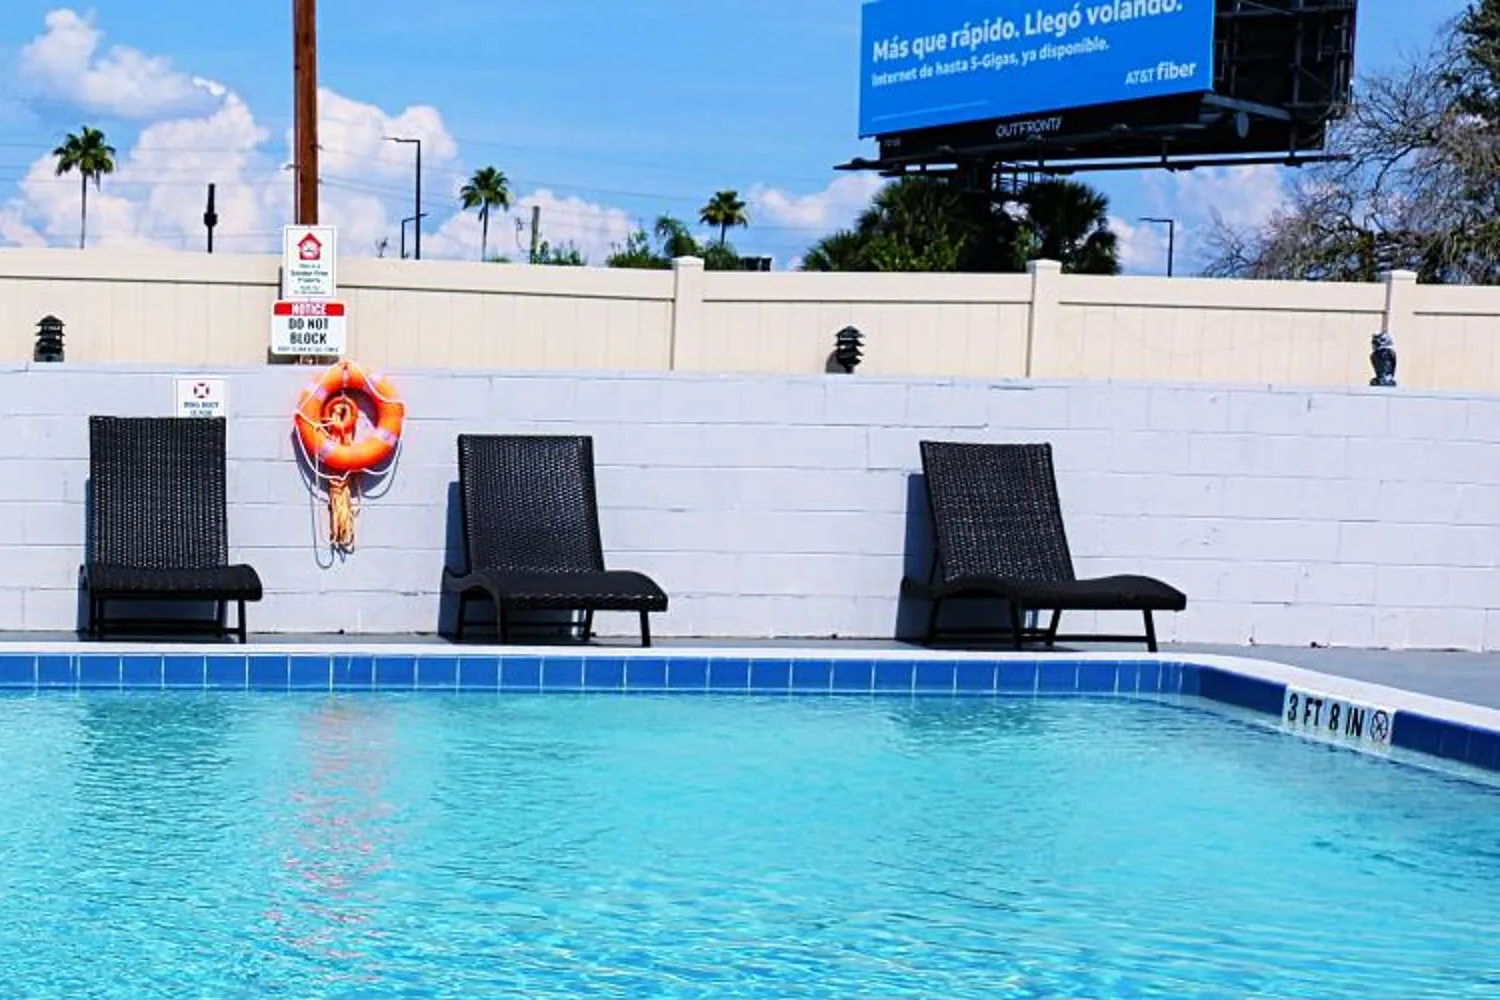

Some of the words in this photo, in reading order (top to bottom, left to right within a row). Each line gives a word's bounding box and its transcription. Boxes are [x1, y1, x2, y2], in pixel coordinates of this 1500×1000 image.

[872, 35, 909, 62] Más
[912, 33, 946, 60] que
[951, 17, 1020, 51] rápido.
[1024, 1, 1081, 38] Llegó
[871, 69, 917, 87] Internet
[919, 64, 933, 79] de
[935, 60, 969, 76] hasta
[1021, 49, 1036, 66] ya
[1039, 35, 1111, 60] disponible.
[1125, 68, 1155, 85] AT&T
[1156, 60, 1197, 81] fiber
[292, 303, 327, 315] NOTICE
[289, 318, 304, 330] DO
[308, 318, 328, 330] NOT
[290, 332, 327, 344] BLOCK
[1287, 693, 1298, 721] 3
[1304, 697, 1322, 726] FT
[1329, 703, 1340, 731] 8
[1345, 706, 1364, 736] IN
